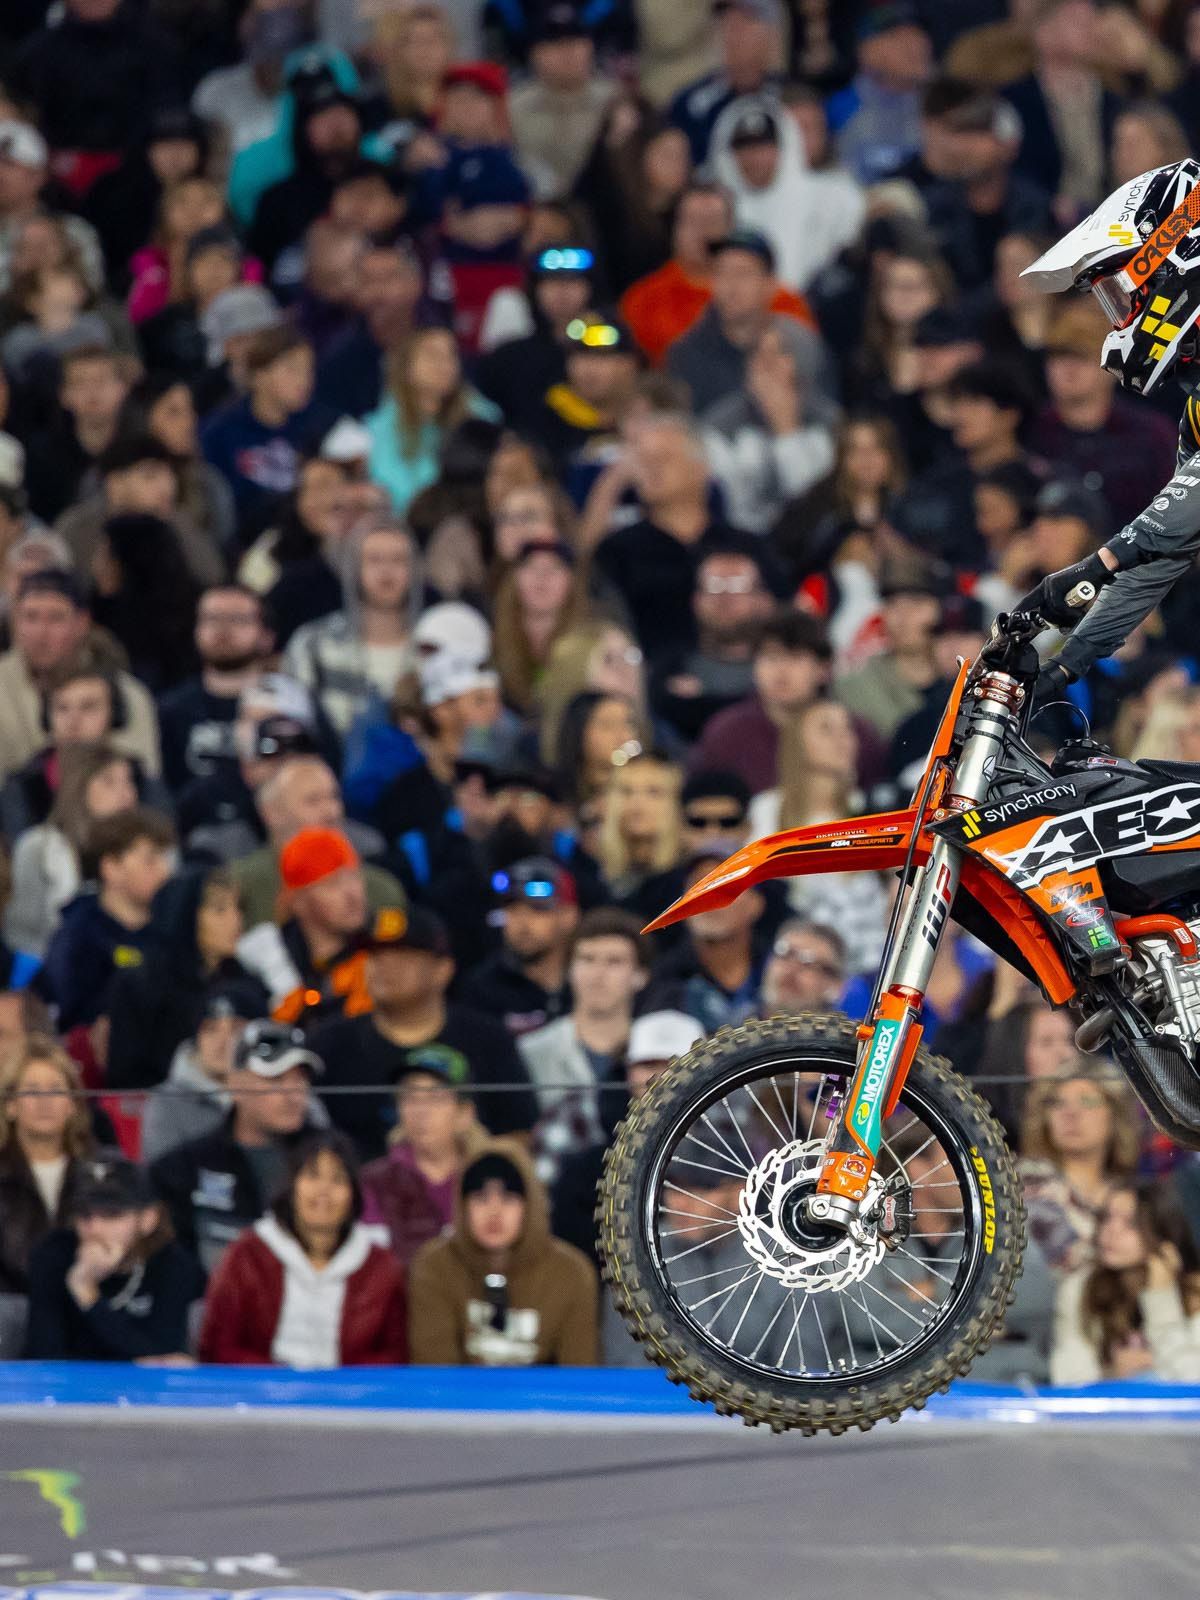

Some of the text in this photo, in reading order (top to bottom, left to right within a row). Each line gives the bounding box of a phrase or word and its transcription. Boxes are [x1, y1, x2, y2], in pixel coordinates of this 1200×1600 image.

[1133, 204, 1193, 276] OAKLEY
[984, 783, 1078, 823] synchrony
[861, 1025, 896, 1103] MOTOREX
[972, 1156, 996, 1255] DUNLOP
